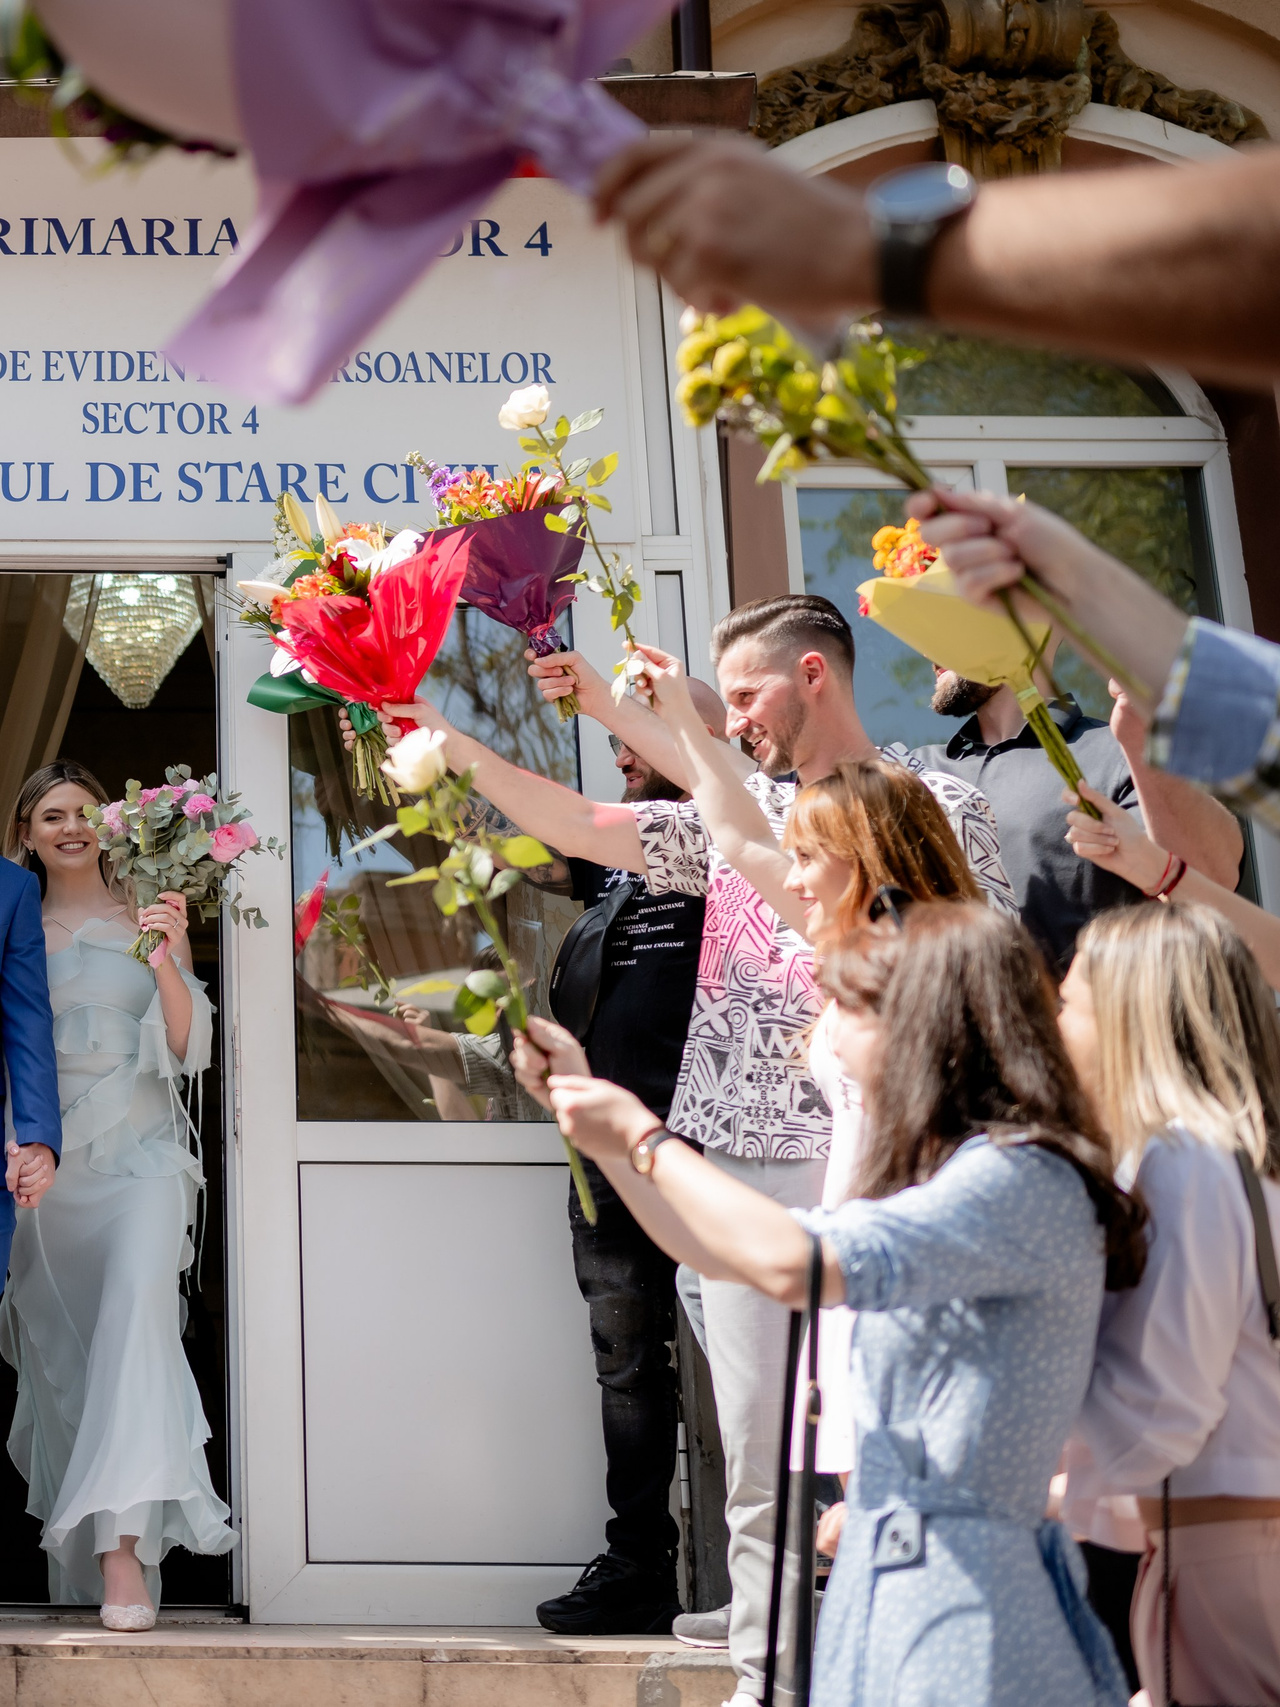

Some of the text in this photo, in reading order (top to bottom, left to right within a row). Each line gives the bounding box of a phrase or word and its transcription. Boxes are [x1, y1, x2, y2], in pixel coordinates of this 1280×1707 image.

[523, 221, 553, 257] 4
[42, 350, 219, 383] EVIDEN
[325, 350, 557, 384] RSOANELOR
[82, 401, 260, 435] SECTOR 4
[84, 462, 163, 504] DE
[178, 461, 349, 504] STARE
[637, 901, 685, 915] ARMANI EXCHANGE
[647, 923, 675, 933] EXCHANGE
[632, 941, 685, 951] ARMANI EXCHANGE
